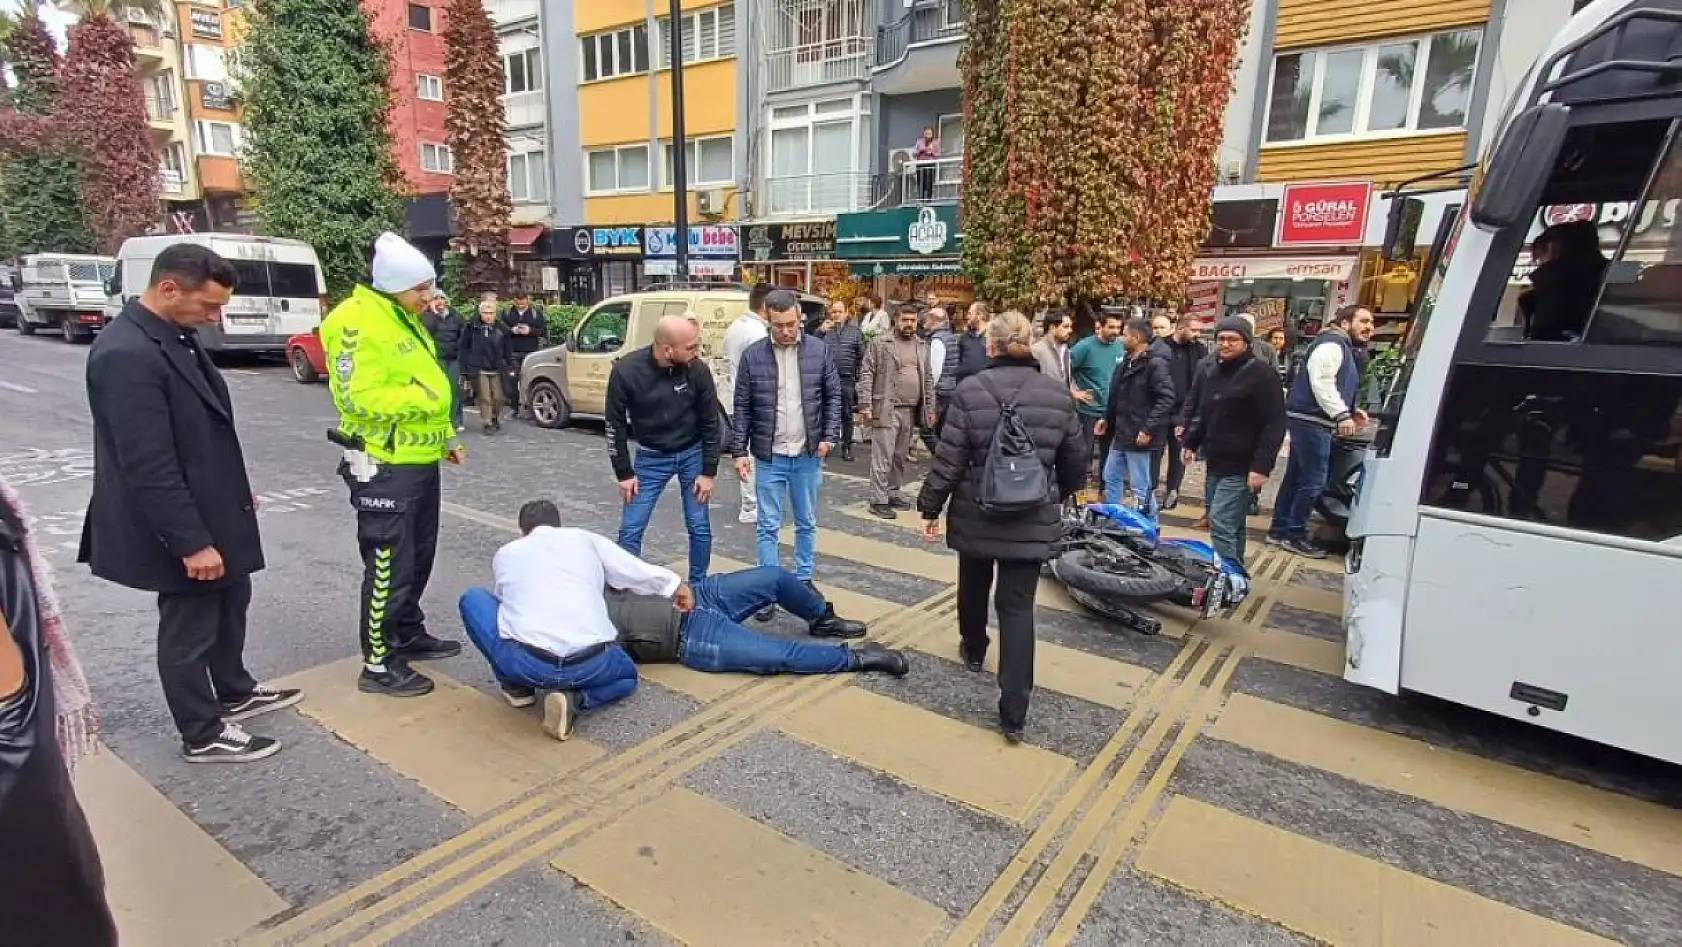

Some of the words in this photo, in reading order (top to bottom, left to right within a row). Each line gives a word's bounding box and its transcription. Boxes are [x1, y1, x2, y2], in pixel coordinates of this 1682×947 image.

[1305, 200, 1356, 213] GÜRAL
[1293, 211, 1355, 222] PORSELEN
[594, 229, 639, 246] BYK
